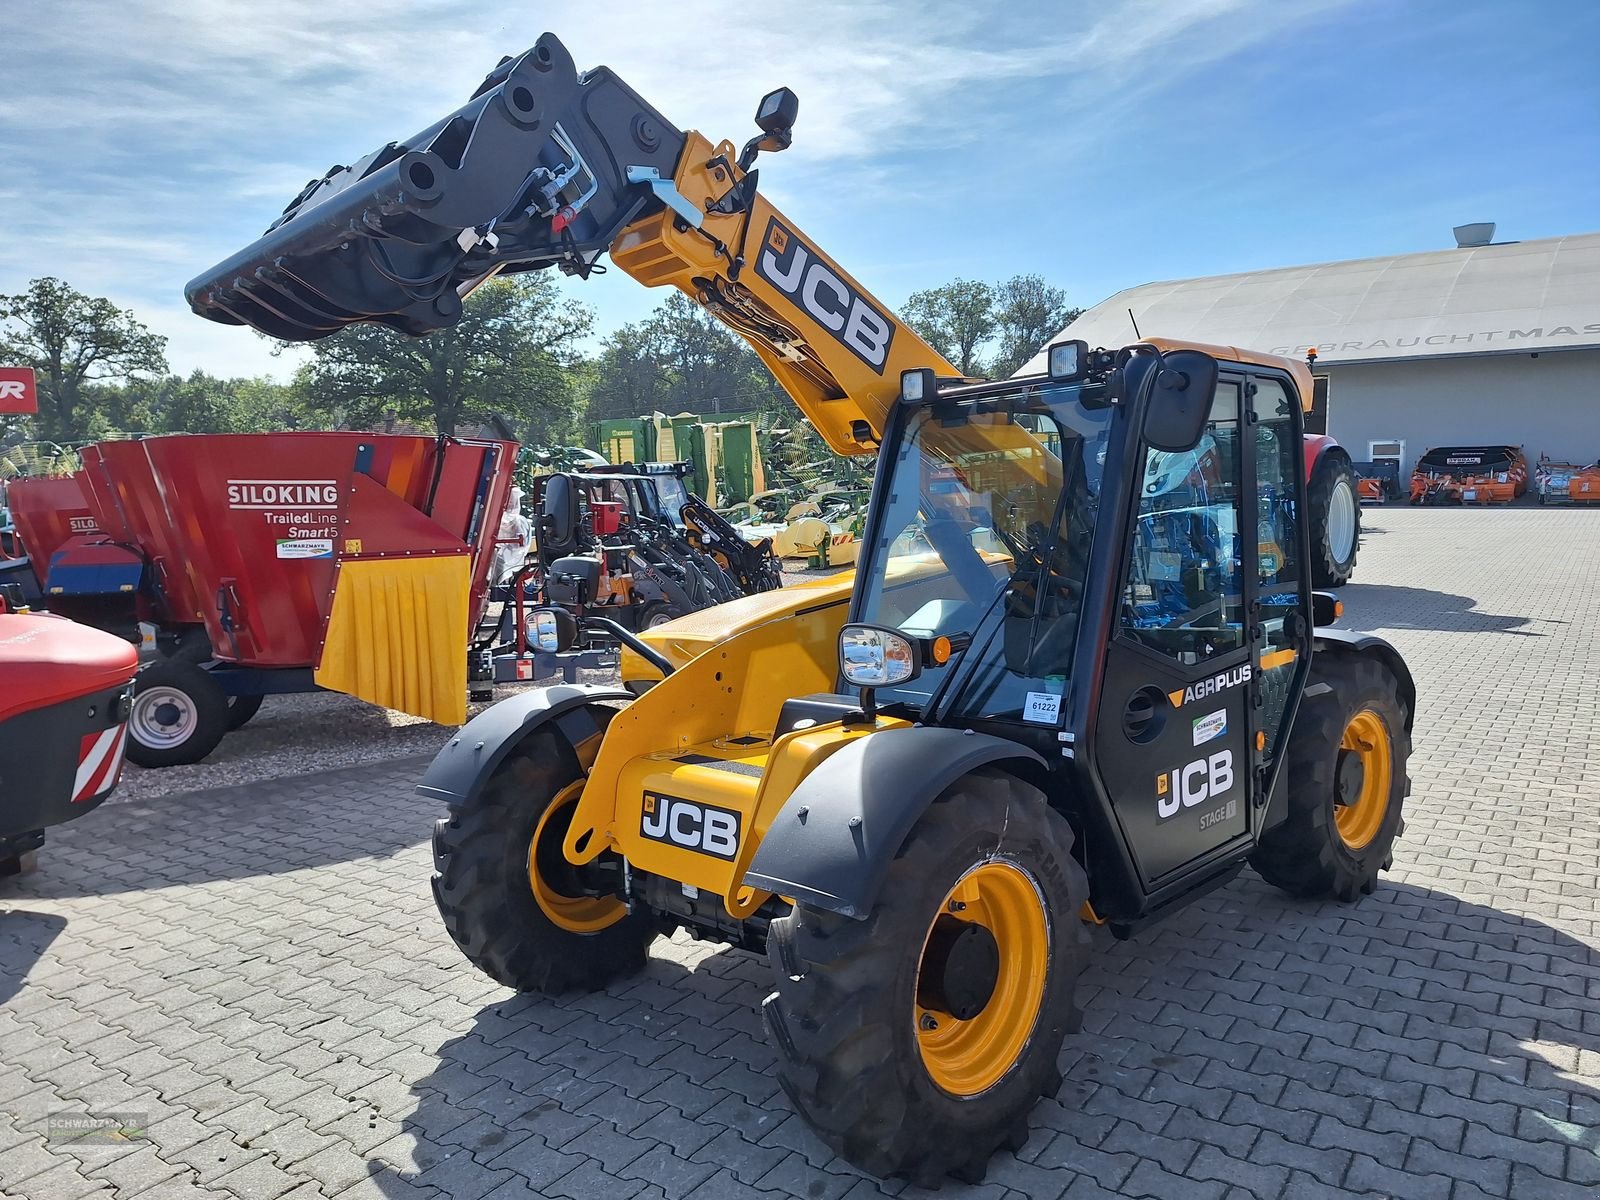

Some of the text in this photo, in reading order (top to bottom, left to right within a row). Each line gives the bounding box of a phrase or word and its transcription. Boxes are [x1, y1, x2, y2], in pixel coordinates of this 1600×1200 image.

[762, 246, 891, 367] JCB
[227, 486, 337, 503] SILOKING
[70, 520, 98, 529] SILO
[264, 512, 337, 524] TrailedLine
[693, 517, 710, 533] JCB
[1032, 702, 1056, 712] 61222
[1158, 749, 1234, 819] JCB
[1200, 806, 1226, 830] STAGE
[643, 798, 738, 856] JCB
